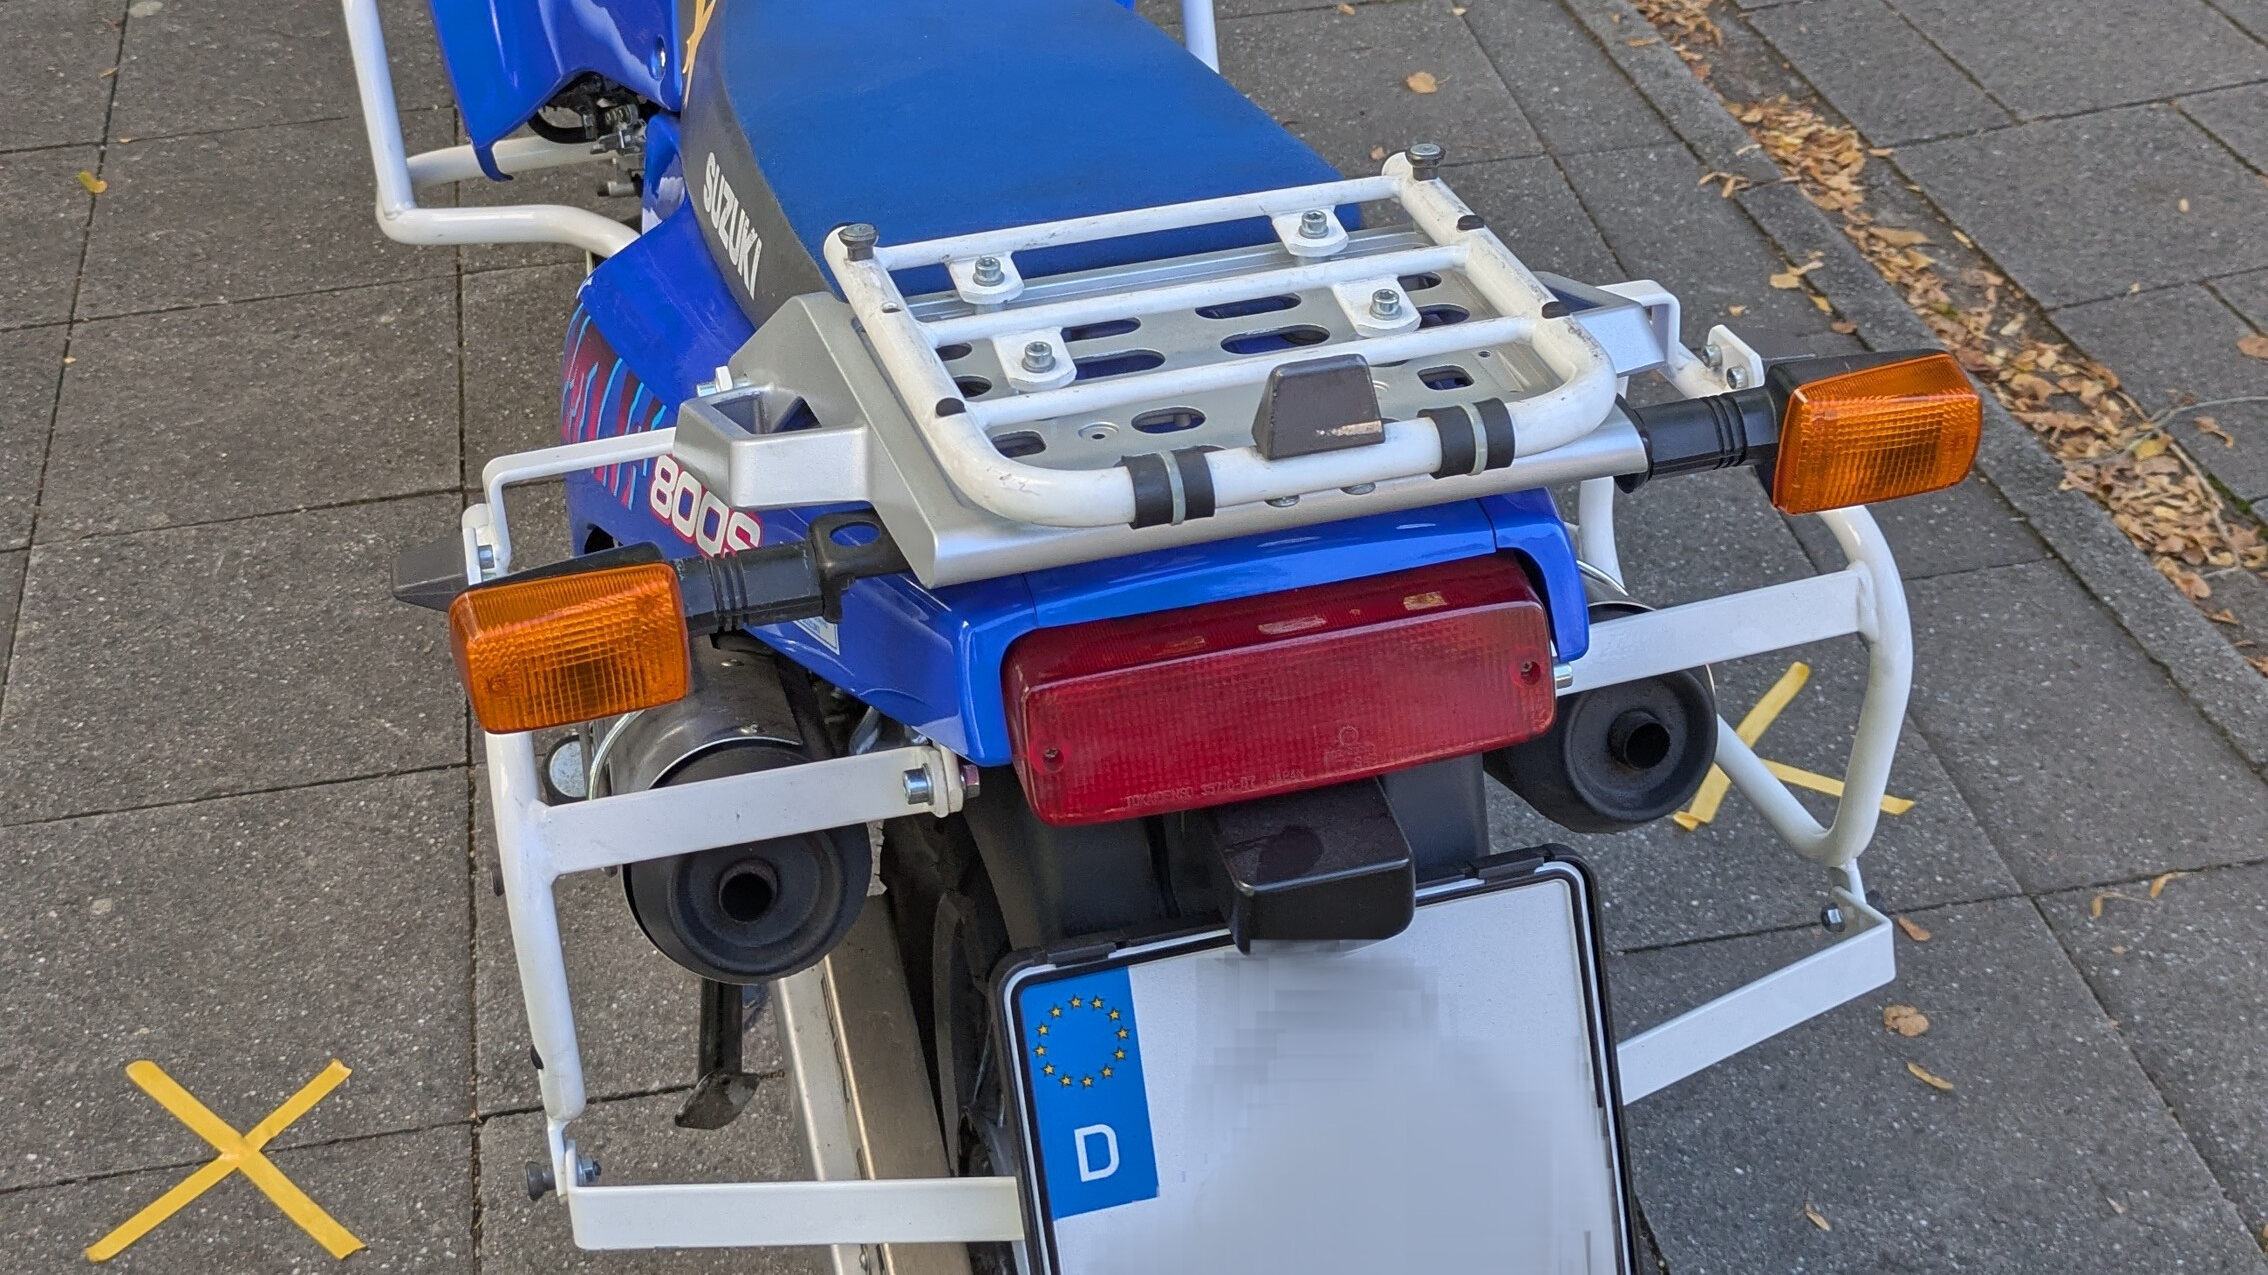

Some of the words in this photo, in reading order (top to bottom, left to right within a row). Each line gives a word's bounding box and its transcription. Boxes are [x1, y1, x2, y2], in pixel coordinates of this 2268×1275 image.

[704, 152, 762, 300] SUZUKI
[650, 454, 760, 557] 800S
[1074, 1124, 1120, 1183] D
